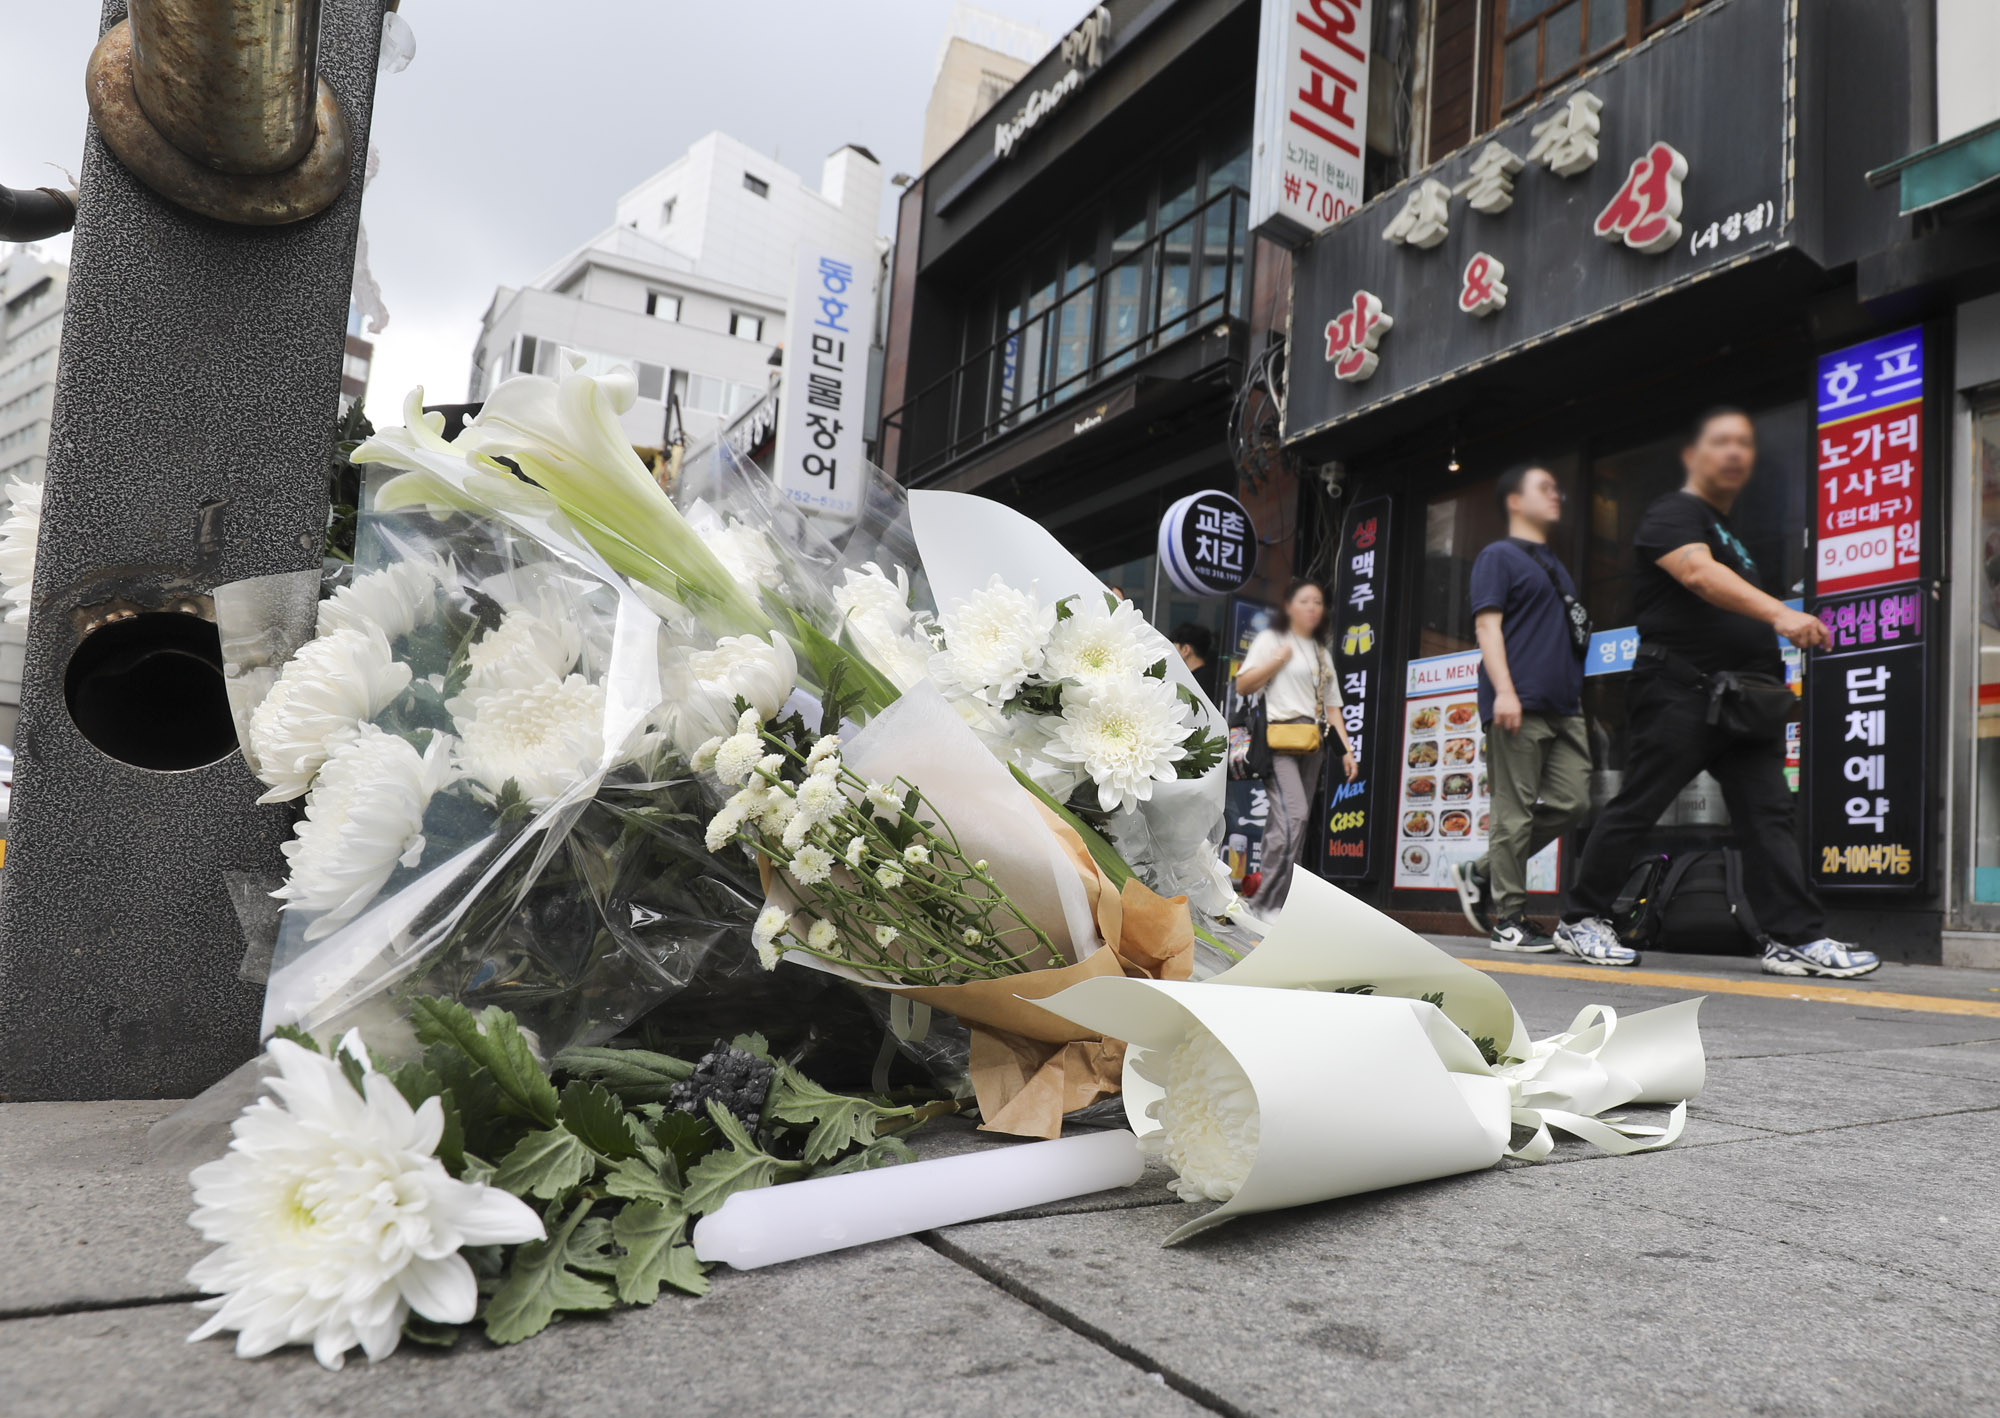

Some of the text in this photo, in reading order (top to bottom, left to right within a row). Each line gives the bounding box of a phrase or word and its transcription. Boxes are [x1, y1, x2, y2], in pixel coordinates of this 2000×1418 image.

[1286, 142, 1319, 177] 노가리
[1284, 170, 1355, 223] ₩7.00
[1817, 343, 1923, 413] 호프
[1818, 413, 1918, 471] 노가리
[1824, 459, 1914, 505] 1사라
[1195, 503, 1245, 541] 교촌
[1826, 495, 1913, 530] (편대구)
[1195, 534, 1243, 571] 치킨
[1824, 537, 1888, 568] 9,000
[1418, 669, 1442, 684] ALL
[1843, 665, 1891, 833] 단체예약
[1330, 779, 1367, 809] Max
